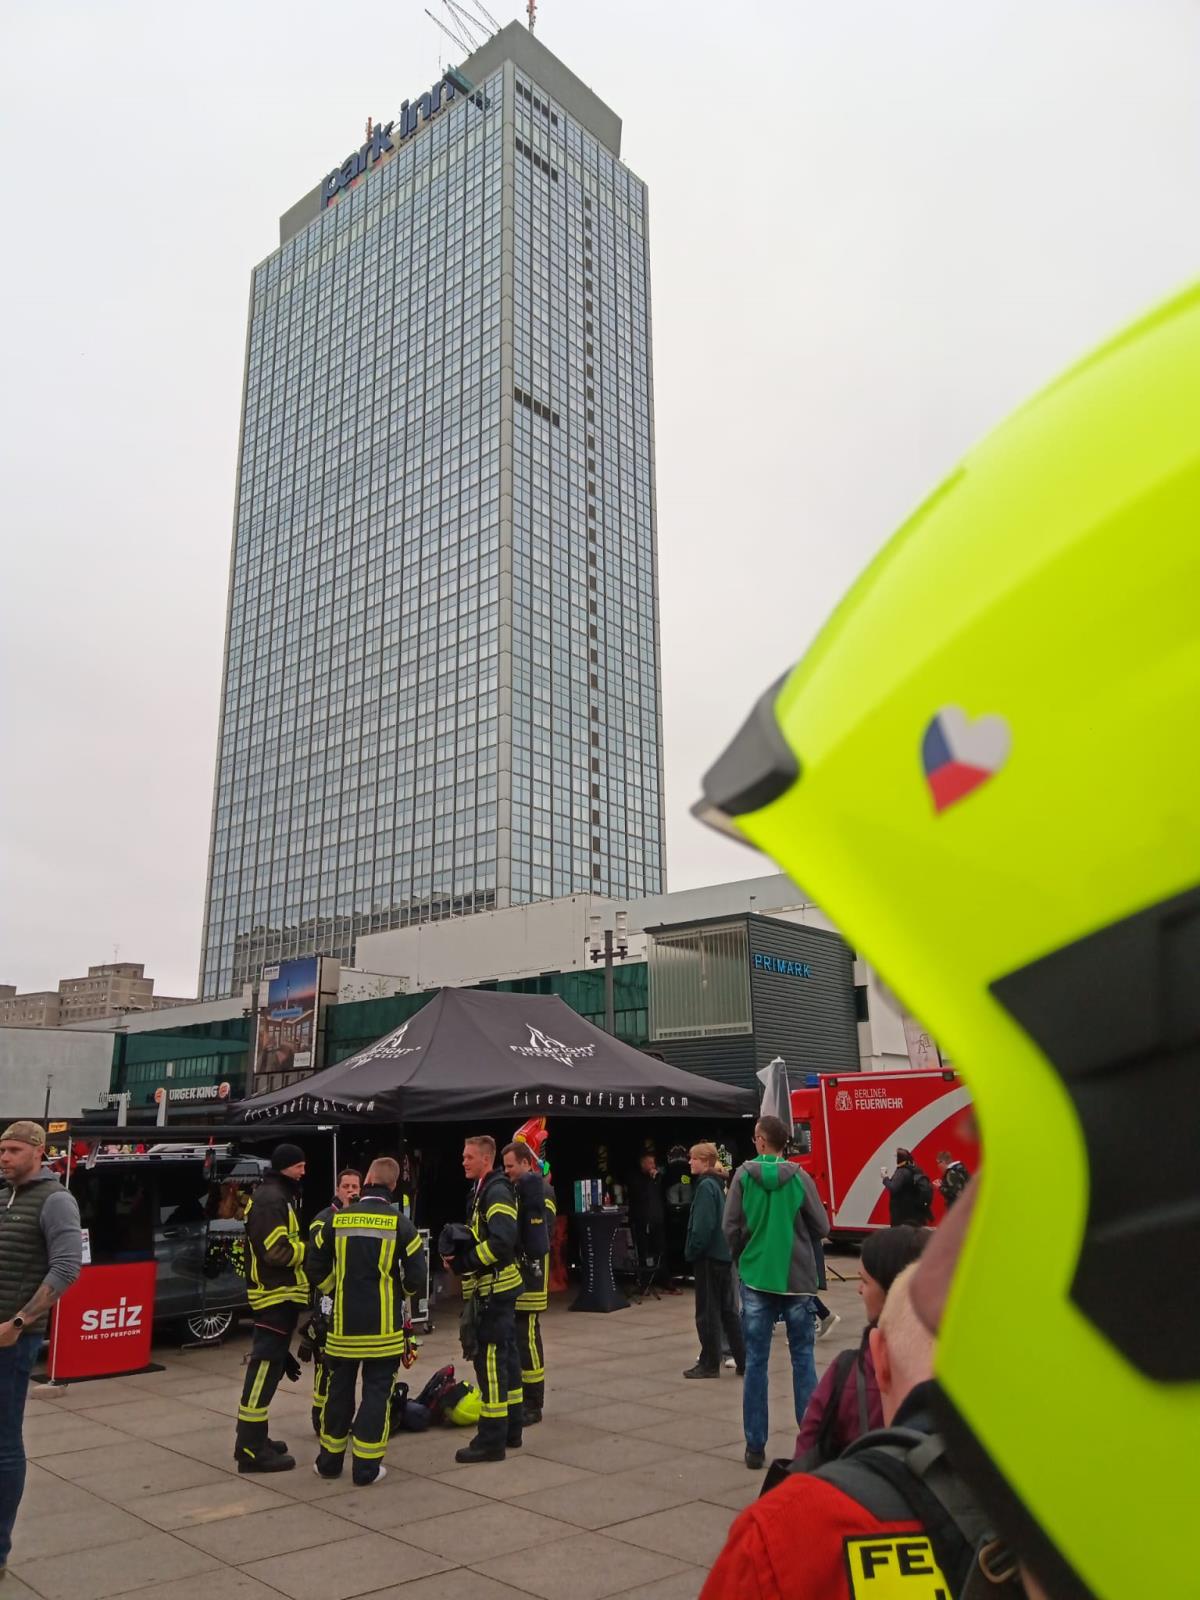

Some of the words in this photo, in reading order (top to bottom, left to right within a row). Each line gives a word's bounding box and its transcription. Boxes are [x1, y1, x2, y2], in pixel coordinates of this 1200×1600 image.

[321, 121, 394, 210] park
[400, 80, 455, 139] inn
[753, 953, 811, 977] PRIMARK
[197, 1085, 219, 1098] KING
[854, 1088, 887, 1098] BERLINER
[513, 1092, 688, 1109] fireandfight.com
[855, 1097, 904, 1110] FEUERWEHR
[336, 1216, 393, 1226] FEUERWEHR
[111, 1329, 141, 1338] PERFORM
[859, 1542, 934, 1579] FE
